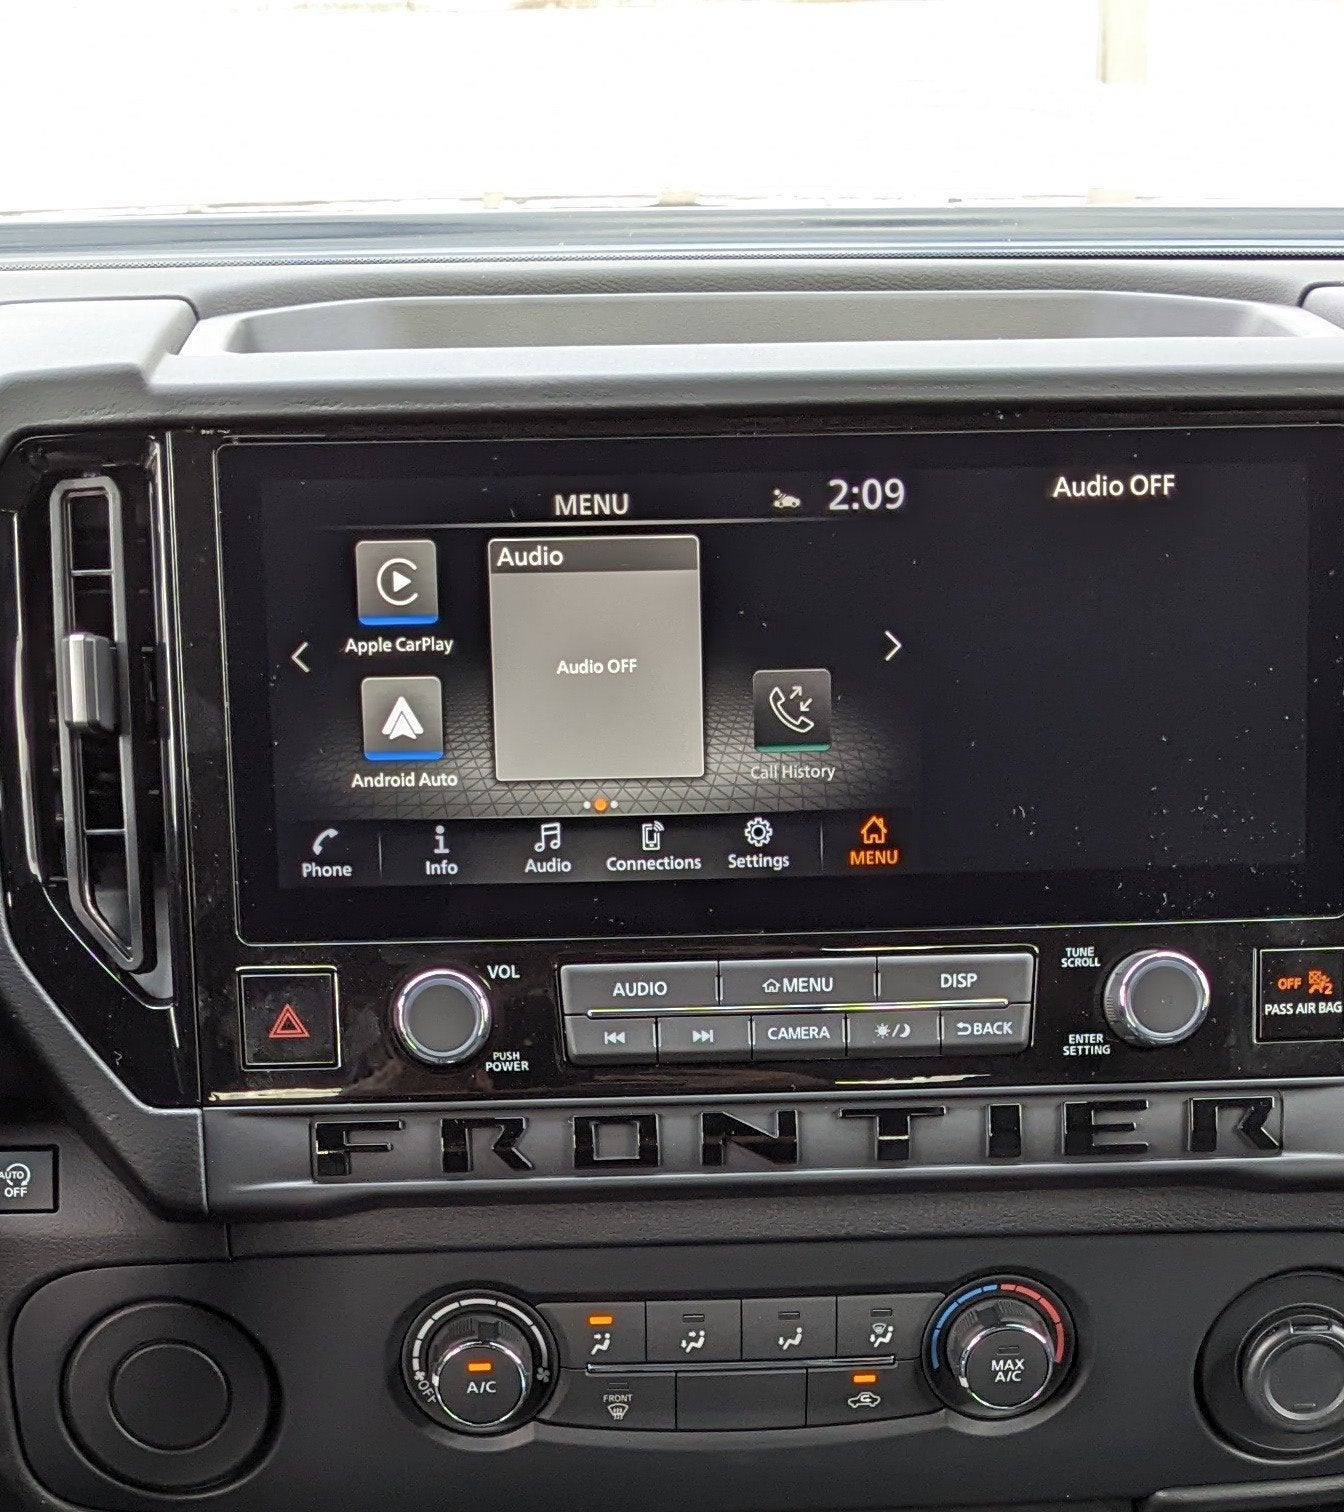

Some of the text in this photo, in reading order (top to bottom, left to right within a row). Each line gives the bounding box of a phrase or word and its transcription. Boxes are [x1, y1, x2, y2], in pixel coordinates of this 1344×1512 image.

[827, 477, 906, 513] 2:09
[1052, 473, 1177, 499] Audio OFF
[554, 493, 629, 517] MENU
[496, 546, 564, 569] Audio
[344, 633, 455, 658] Apple CarPlay
[556, 656, 639, 676] Audio OFF
[351, 770, 459, 789] Android Auto
[750, 761, 837, 784] Call History
[524, 855, 573, 875] Audio
[605, 853, 702, 872] Connections
[726, 850, 790, 872] Settings
[849, 848, 900, 867] MENU
[301, 861, 353, 880] Phone
[424, 858, 459, 877] Info
[1064, 946, 1095, 959] TUNE
[1060, 955, 1101, 969] SCROLL
[486, 964, 521, 981] VOL
[939, 971, 979, 990] DISP
[612, 980, 668, 998] AUDIO
[782, 976, 834, 995] MENU
[1277, 977, 1302, 990] OFF
[1264, 1000, 1343, 1016] PASS AIR BAG
[767, 1024, 831, 1041] CAMERA
[972, 1020, 1013, 1037] BACK
[1068, 1033, 1104, 1046] ENTER
[492, 1050, 521, 1062] PUSH
[1062, 1042, 1111, 1057] SETTING
[485, 1060, 529, 1074] POWER
[312, 1095, 1283, 1180] FRONTIER
[4, 1187, 28, 1198] OFF
[991, 1358, 1025, 1372] MAX
[994, 1369, 1023, 1384] A/C
[466, 1380, 497, 1394] A/C
[603, 1393, 633, 1403] FRONT
